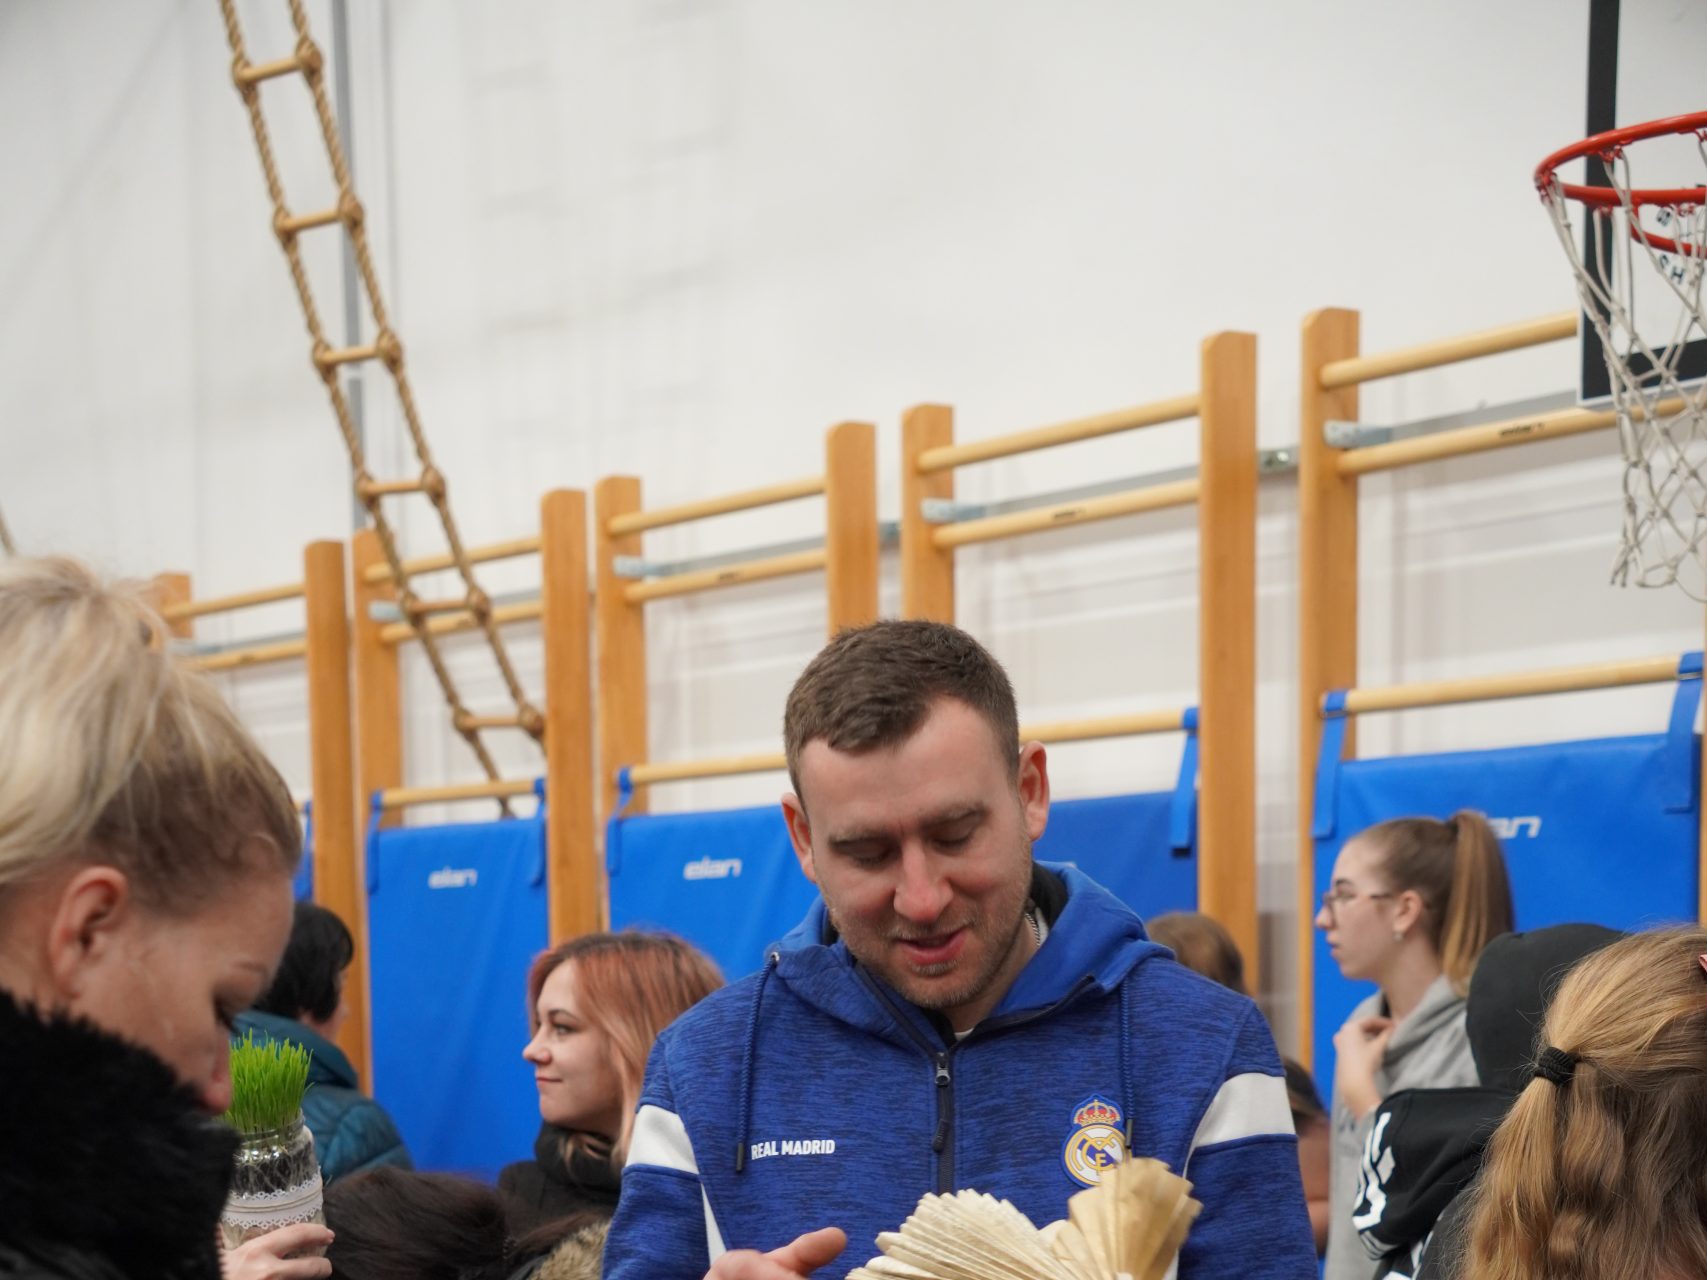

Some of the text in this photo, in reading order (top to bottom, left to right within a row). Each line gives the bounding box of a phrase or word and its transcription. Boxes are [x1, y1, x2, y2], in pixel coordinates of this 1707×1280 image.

[1480, 813, 1542, 838] an
[751, 1140, 836, 1160] REAL MADRID
